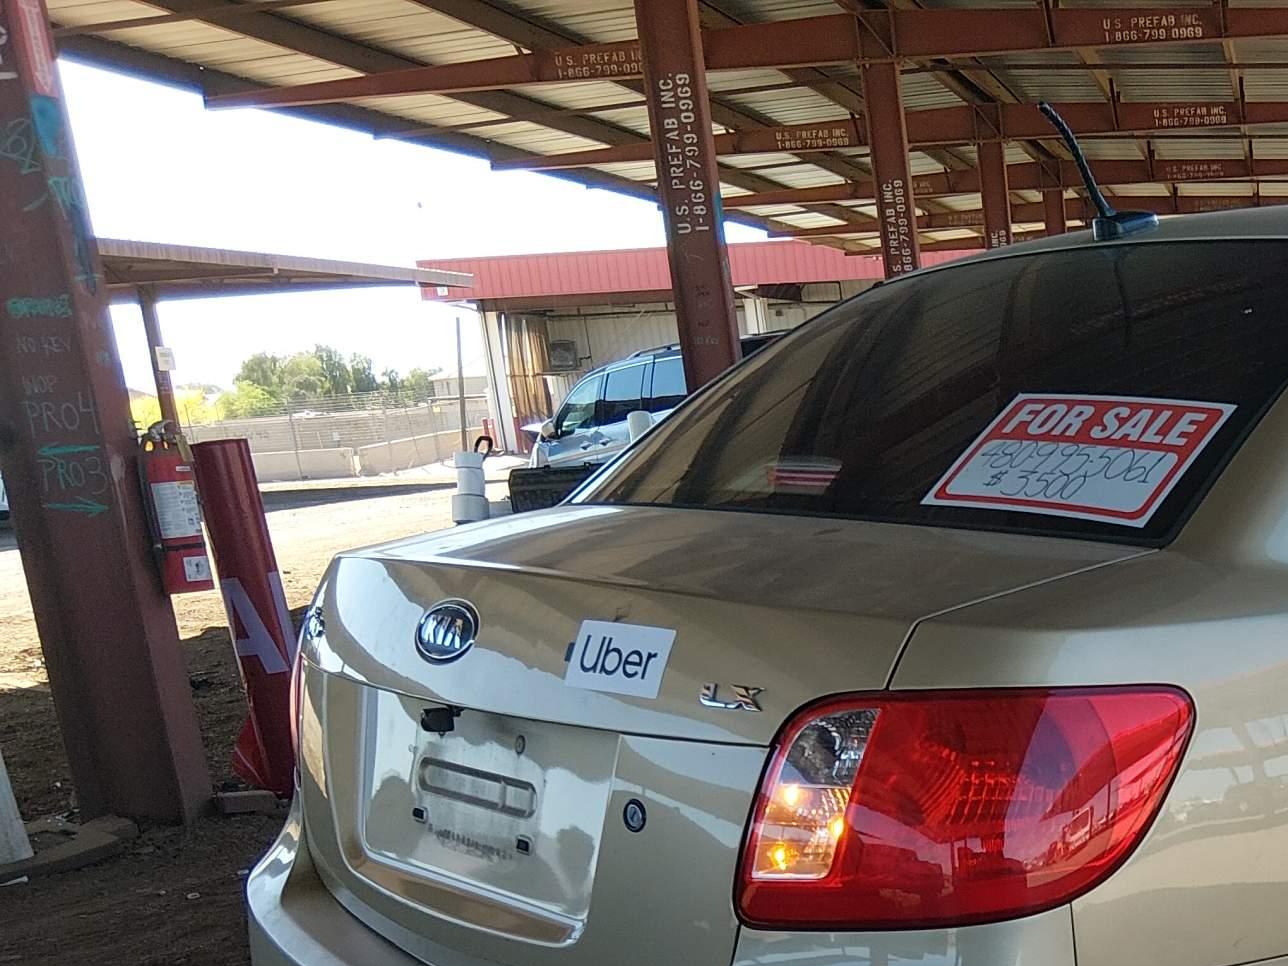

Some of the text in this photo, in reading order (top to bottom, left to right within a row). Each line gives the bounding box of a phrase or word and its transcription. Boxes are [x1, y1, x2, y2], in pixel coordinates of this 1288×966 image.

[1130, 15, 1176, 28] PREFAB
[557, 62, 644, 79] 1-866-799-09
[582, 51, 626, 66] PREFAB
[832, 128, 849, 138] INC.
[658, 73, 692, 234] U.S. PREFAB INC.
[675, 73, 710, 231] 1-866-799-0969
[882, 179, 892, 203] INC.
[886, 208, 900, 255] PREFAB
[893, 180, 913, 271] 866-799-0969
[1001, 403, 1208, 446] FOR SALE
[420, 614, 465, 650] KIA
[578, 634, 658, 680] Uber
[699, 682, 766, 712] LX
